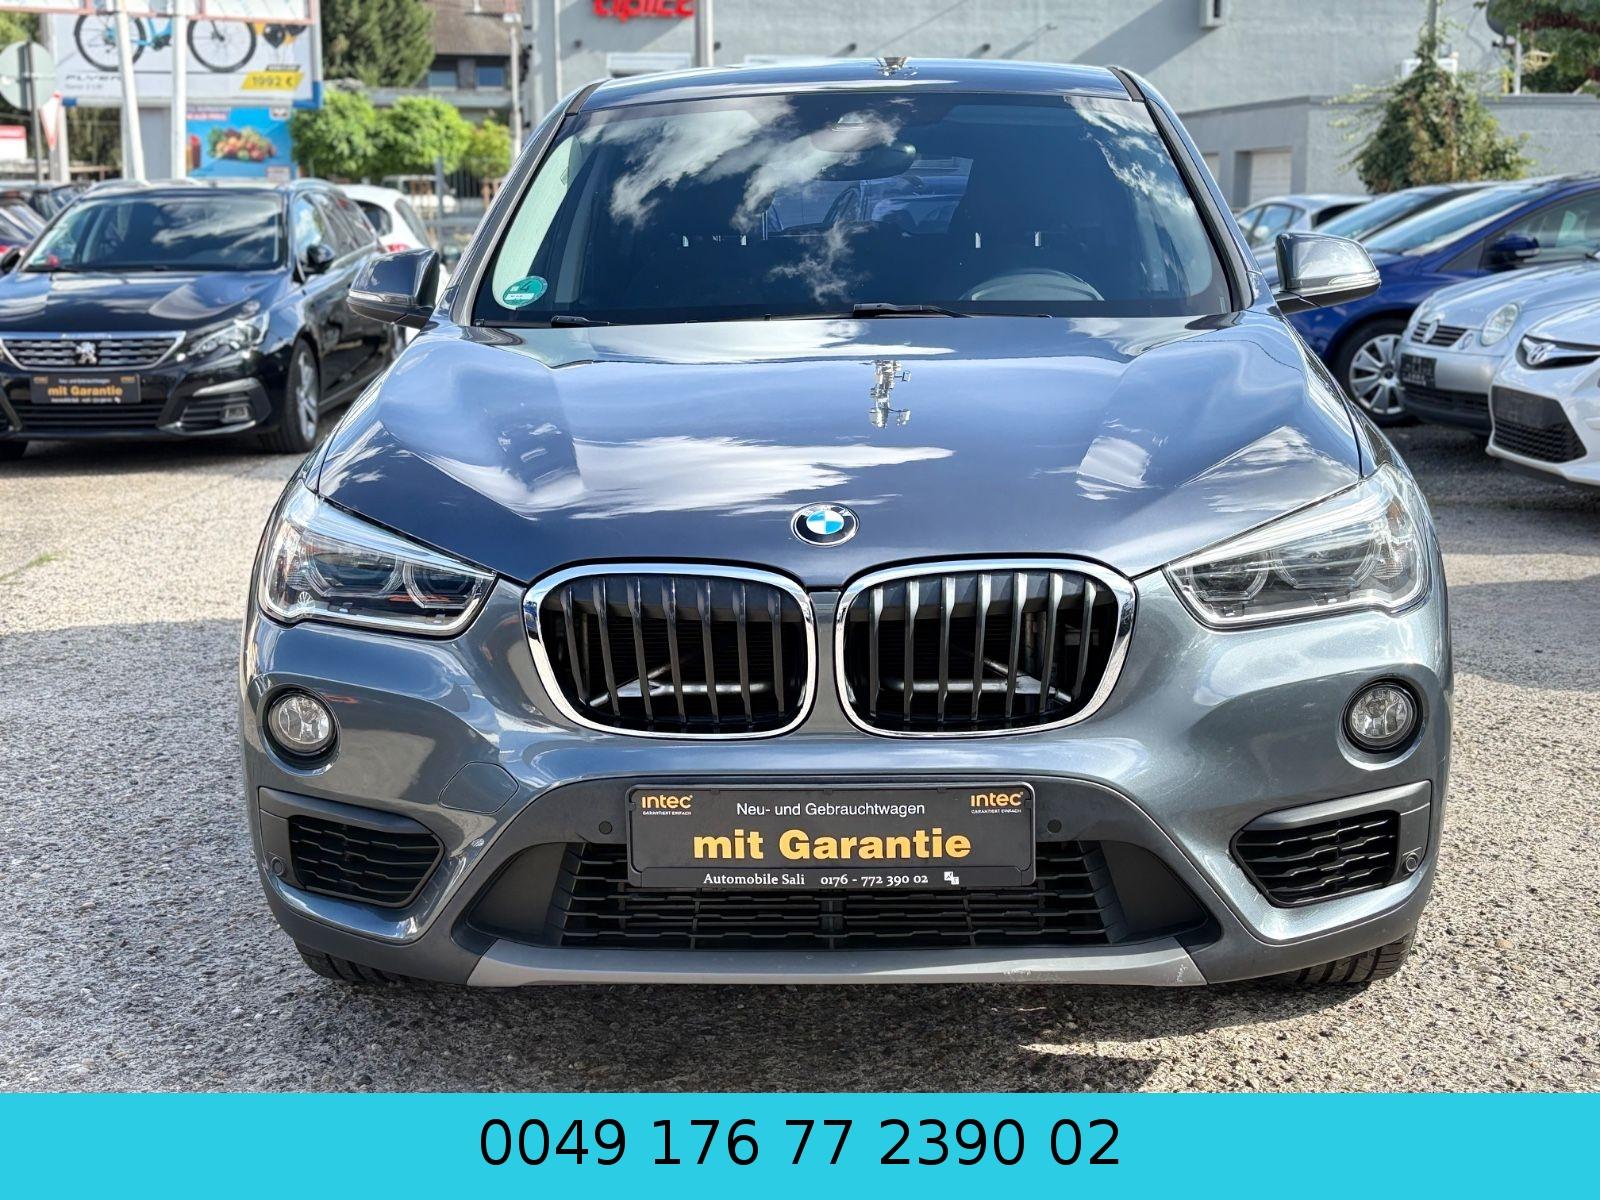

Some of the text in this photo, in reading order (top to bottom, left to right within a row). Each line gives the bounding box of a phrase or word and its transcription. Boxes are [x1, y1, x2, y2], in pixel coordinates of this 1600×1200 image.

[48, 385, 123, 397] mit Garantie
[736, 803, 926, 818] Neu- und Gebrauchtwagen
[693, 827, 972, 860] mit Garantie
[703, 873, 779, 885] Automobile
[781, 873, 805, 885] Sali
[820, 873, 849, 888] 0176
[860, 875, 884, 888] 772
[886, 875, 910, 888] 390
[913, 875, 929, 884] 02
